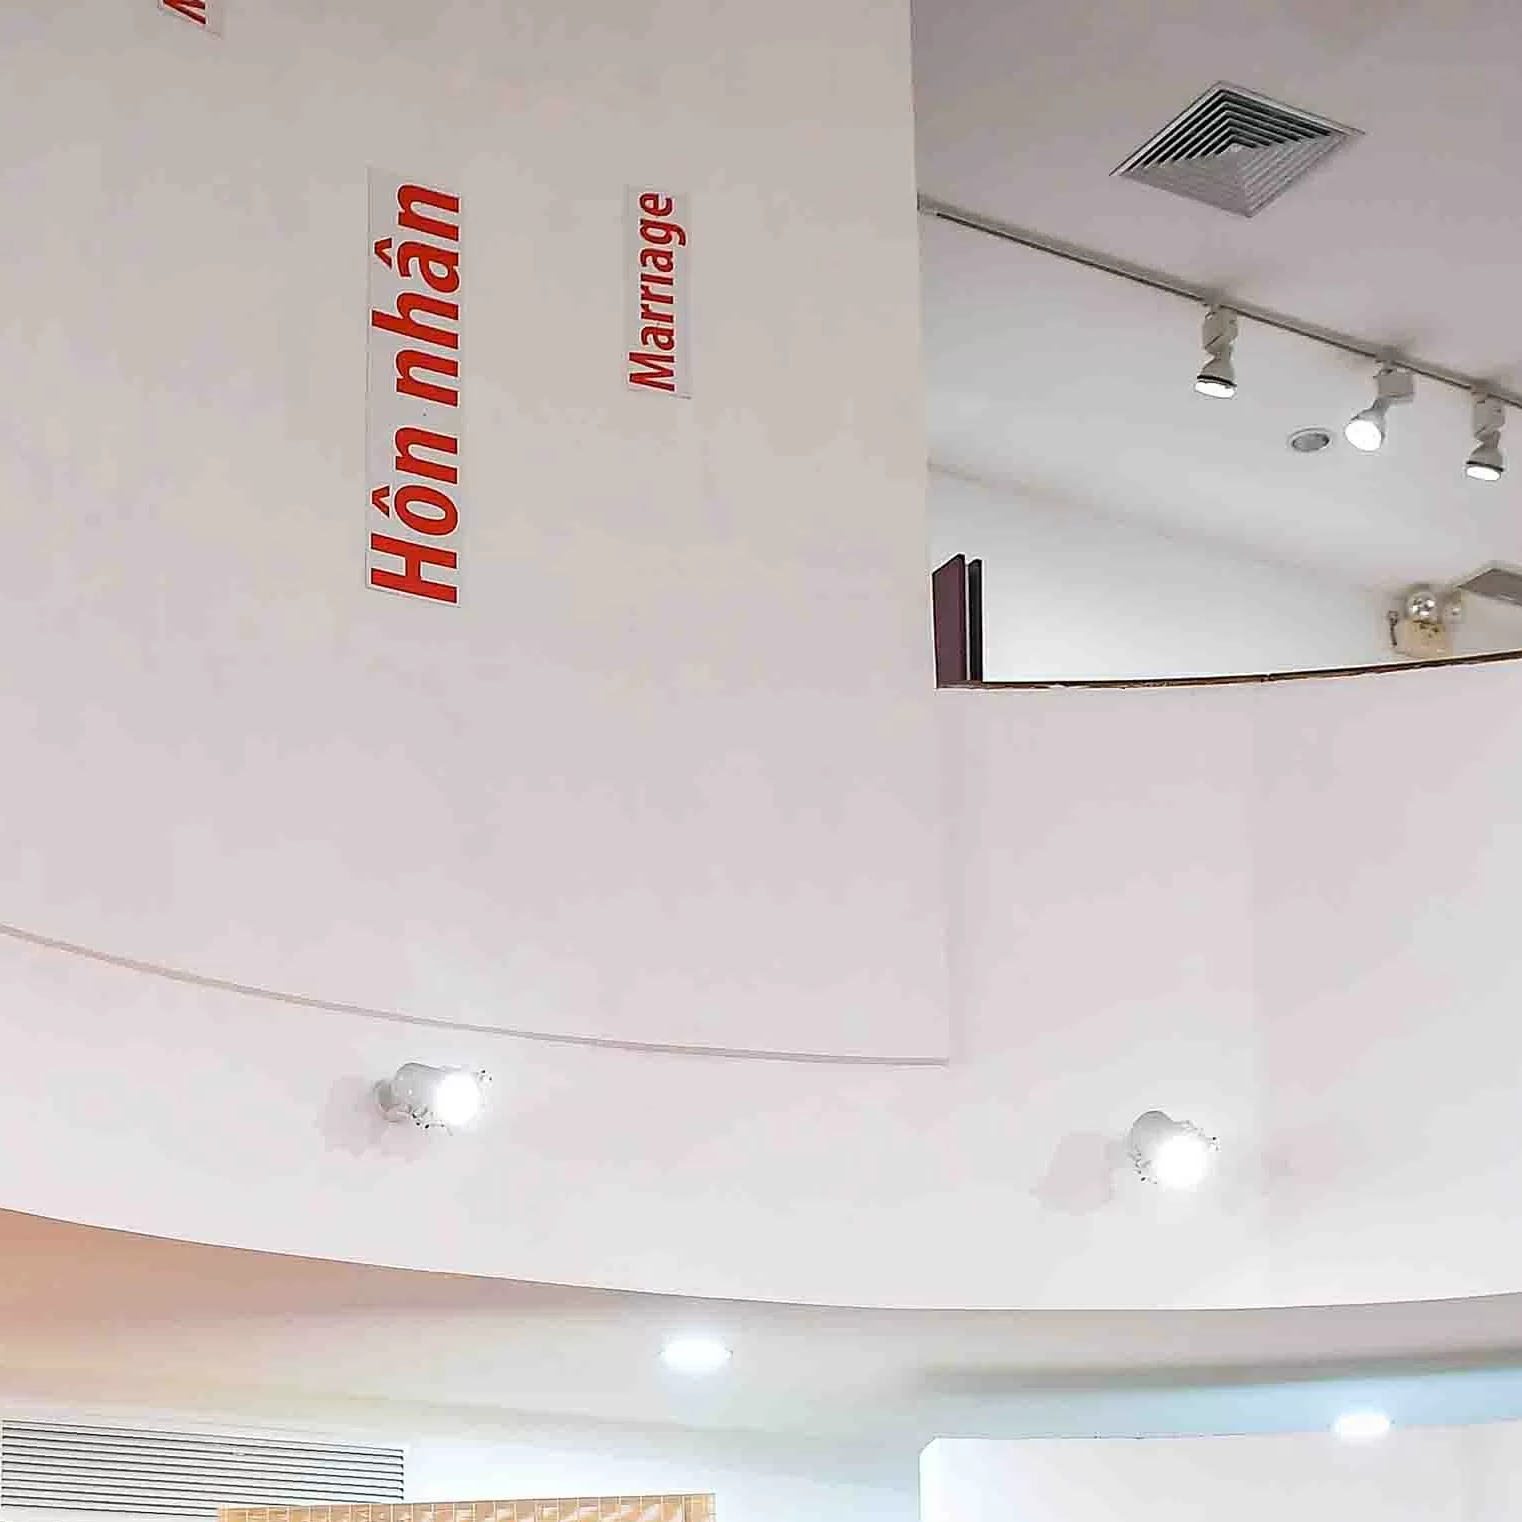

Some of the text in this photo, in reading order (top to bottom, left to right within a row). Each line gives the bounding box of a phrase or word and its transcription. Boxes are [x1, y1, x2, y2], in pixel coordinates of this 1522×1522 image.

[370, 183, 461, 605] Hôn nhân
[629, 191, 687, 391] Marriage
